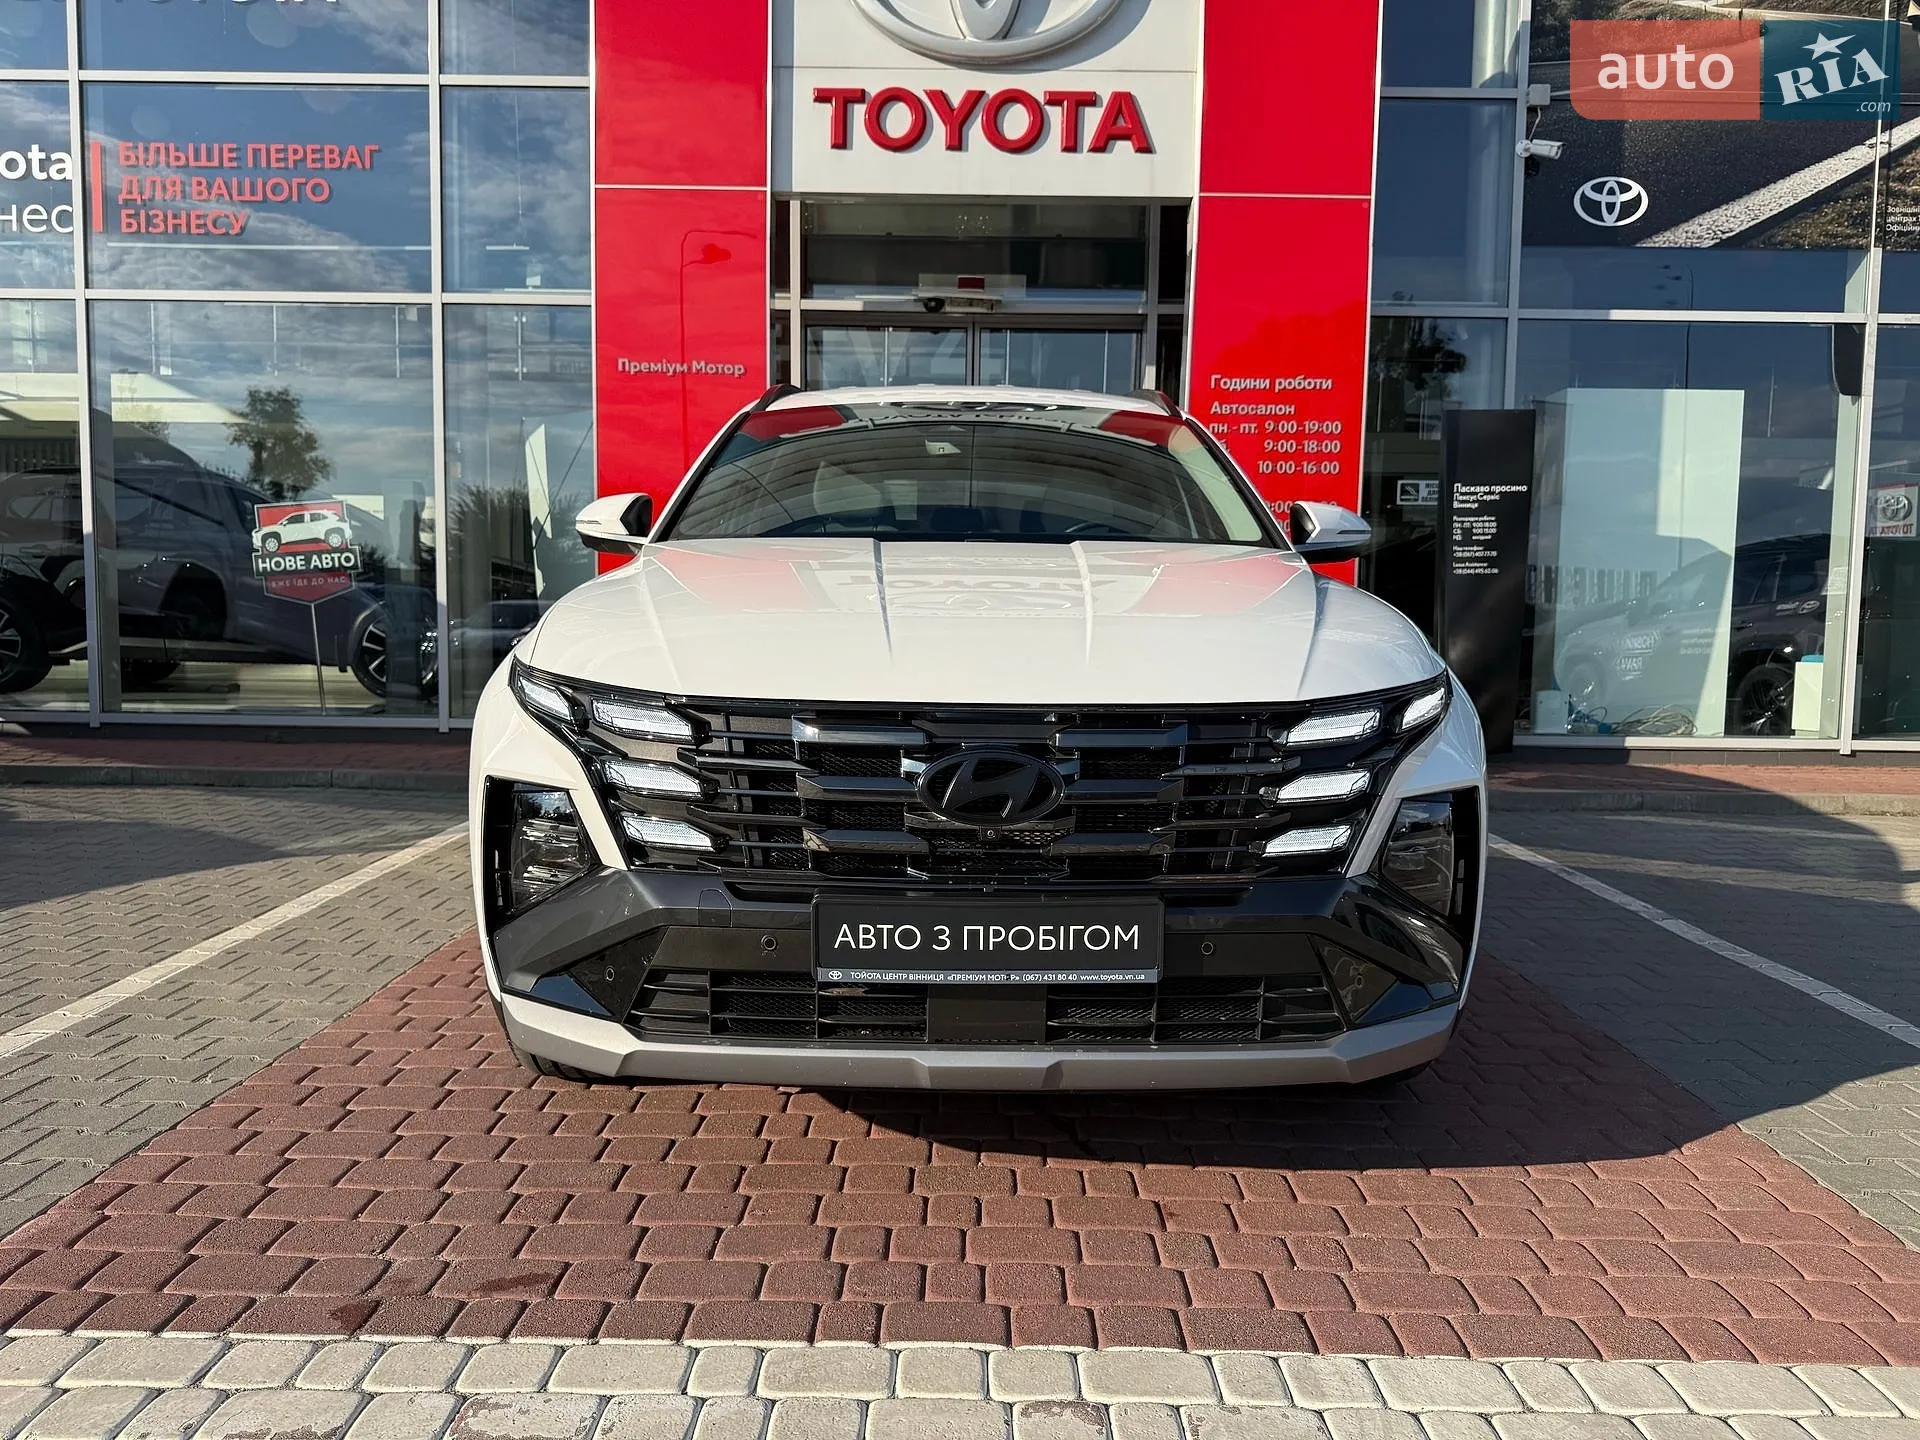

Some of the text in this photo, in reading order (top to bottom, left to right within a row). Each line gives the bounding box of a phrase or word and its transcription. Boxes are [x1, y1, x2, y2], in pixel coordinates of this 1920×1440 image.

[813, 87, 1154, 154] TOYOTA
[118, 141, 380, 169] БІЛЬШЕ ПЕРЕВАГ
[118, 176, 331, 204] ДЛЯ ВАШОГО
[120, 209, 248, 236] БІЗНЕСУ
[618, 358, 745, 377] Преміум Мотор
[1210, 375, 1332, 392] Години роботи
[1210, 401, 1295, 415] Автосалон
[1264, 420, 1342, 434] 9:00-19:00
[1263, 440, 1341, 453] 9:00-18:00
[1491, 485, 1528, 493] просимо
[258, 551, 355, 573] НОВЕ АВТО
[311, 577, 325, 586] ДО
[833, 923, 1139, 951] АВТО З ПРОБІГОМ
[851, 971, 882, 980] ТОЙОТА
[882, 973, 908, 981] ЦЕНТР
[909, 973, 944, 982] ВІННИЦЯ
[1022, 973, 1042, 982] (067)
[1043, 973, 1056, 981] 431
[1057, 973, 1067, 981] 80
[1068, 973, 1078, 981] 40
[1080, 974, 1145, 982] www.toyota.vn.ua
